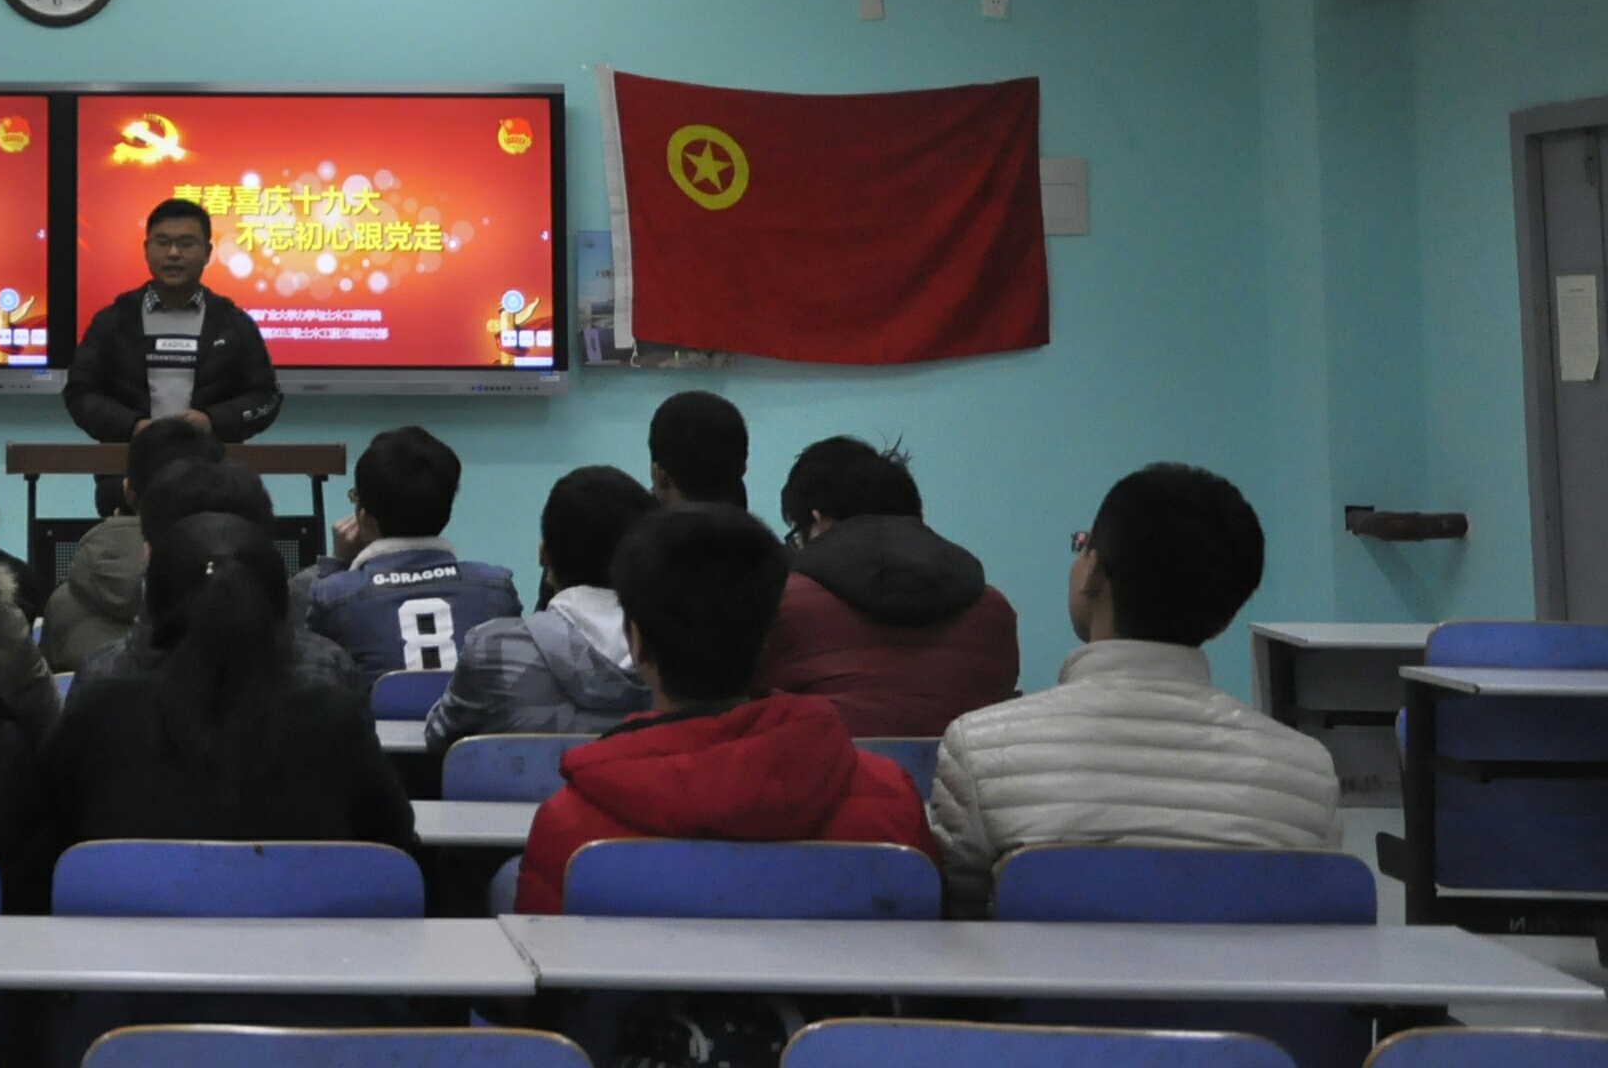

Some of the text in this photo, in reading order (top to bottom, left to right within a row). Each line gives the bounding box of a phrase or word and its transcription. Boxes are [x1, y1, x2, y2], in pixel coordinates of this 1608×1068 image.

[236, 221, 443, 251] 不忘初心跟党走
[373, 566, 457, 585] G-DRAGON
[398, 597, 458, 671] 8
